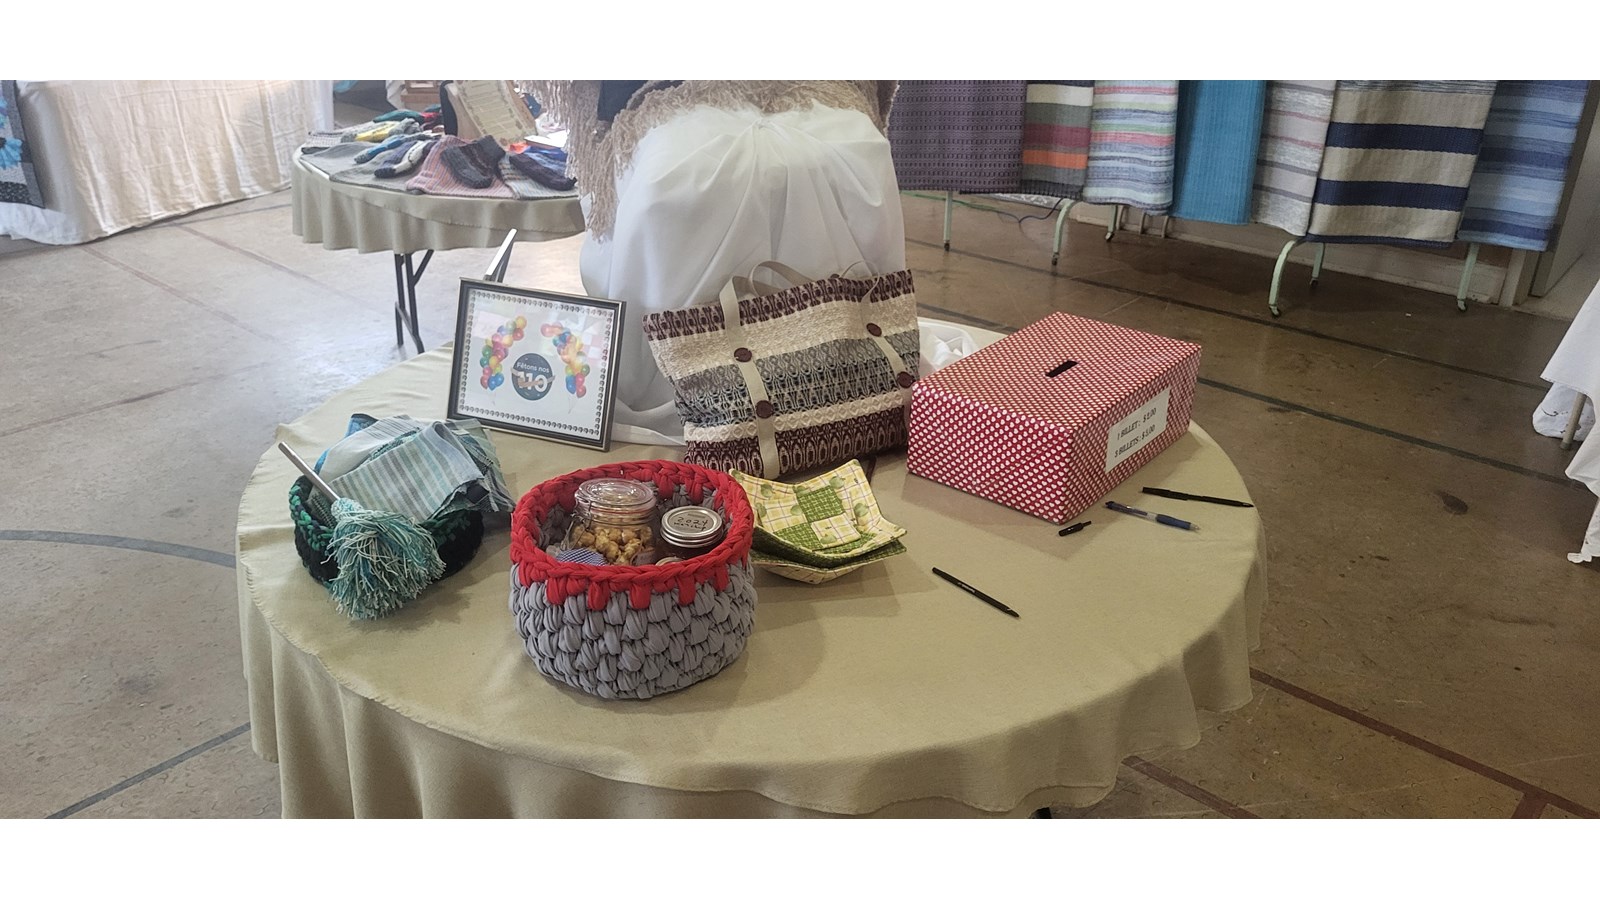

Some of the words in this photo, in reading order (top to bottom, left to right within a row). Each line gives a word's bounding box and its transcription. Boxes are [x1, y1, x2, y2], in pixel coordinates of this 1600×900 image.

[517, 362, 537, 371] Fêtons
[517, 371, 548, 393] 110
[677, 516, 708, 526] 2024
